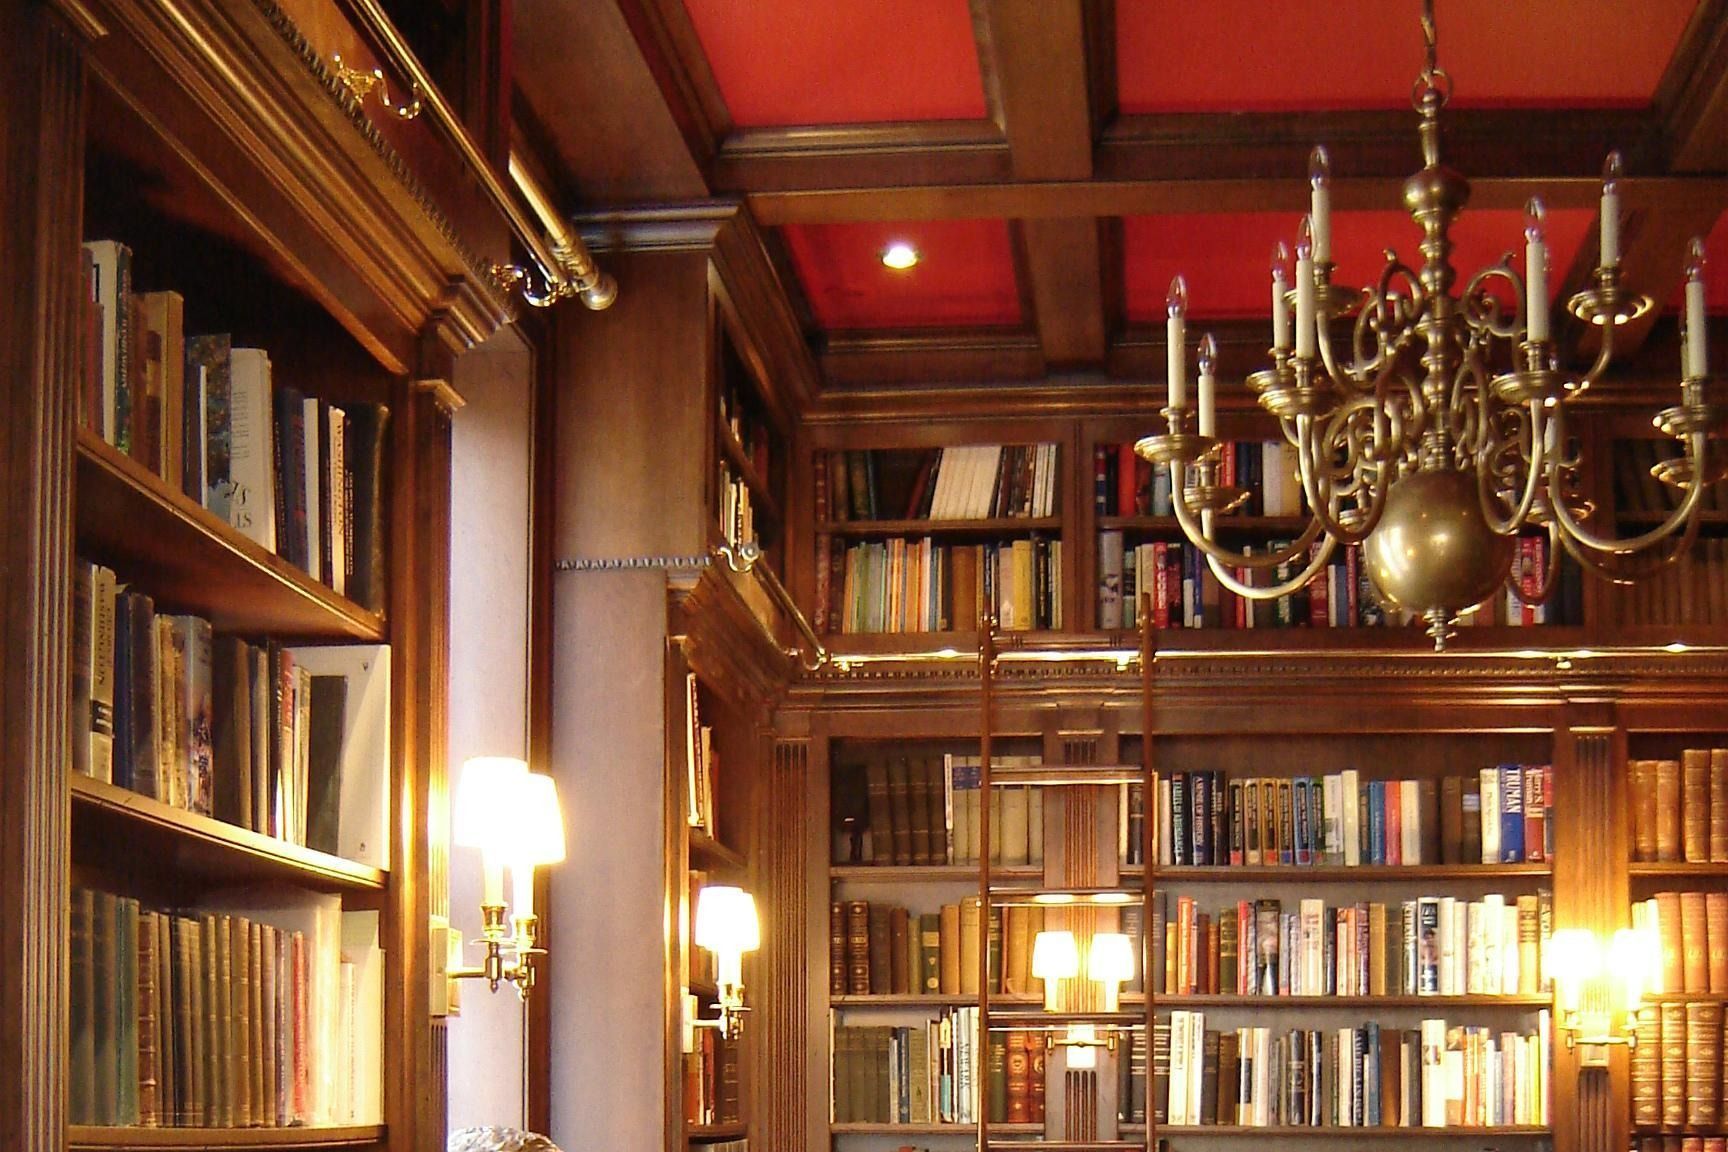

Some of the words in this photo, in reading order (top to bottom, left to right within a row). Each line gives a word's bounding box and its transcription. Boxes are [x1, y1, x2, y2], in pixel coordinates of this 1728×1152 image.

[336, 424, 344, 536] WASHINGTON
[98, 582, 106, 686] WASHINGTON
[1506, 768, 1521, 813] TRUMAN
[1196, 816, 1204, 846] HISTORY
